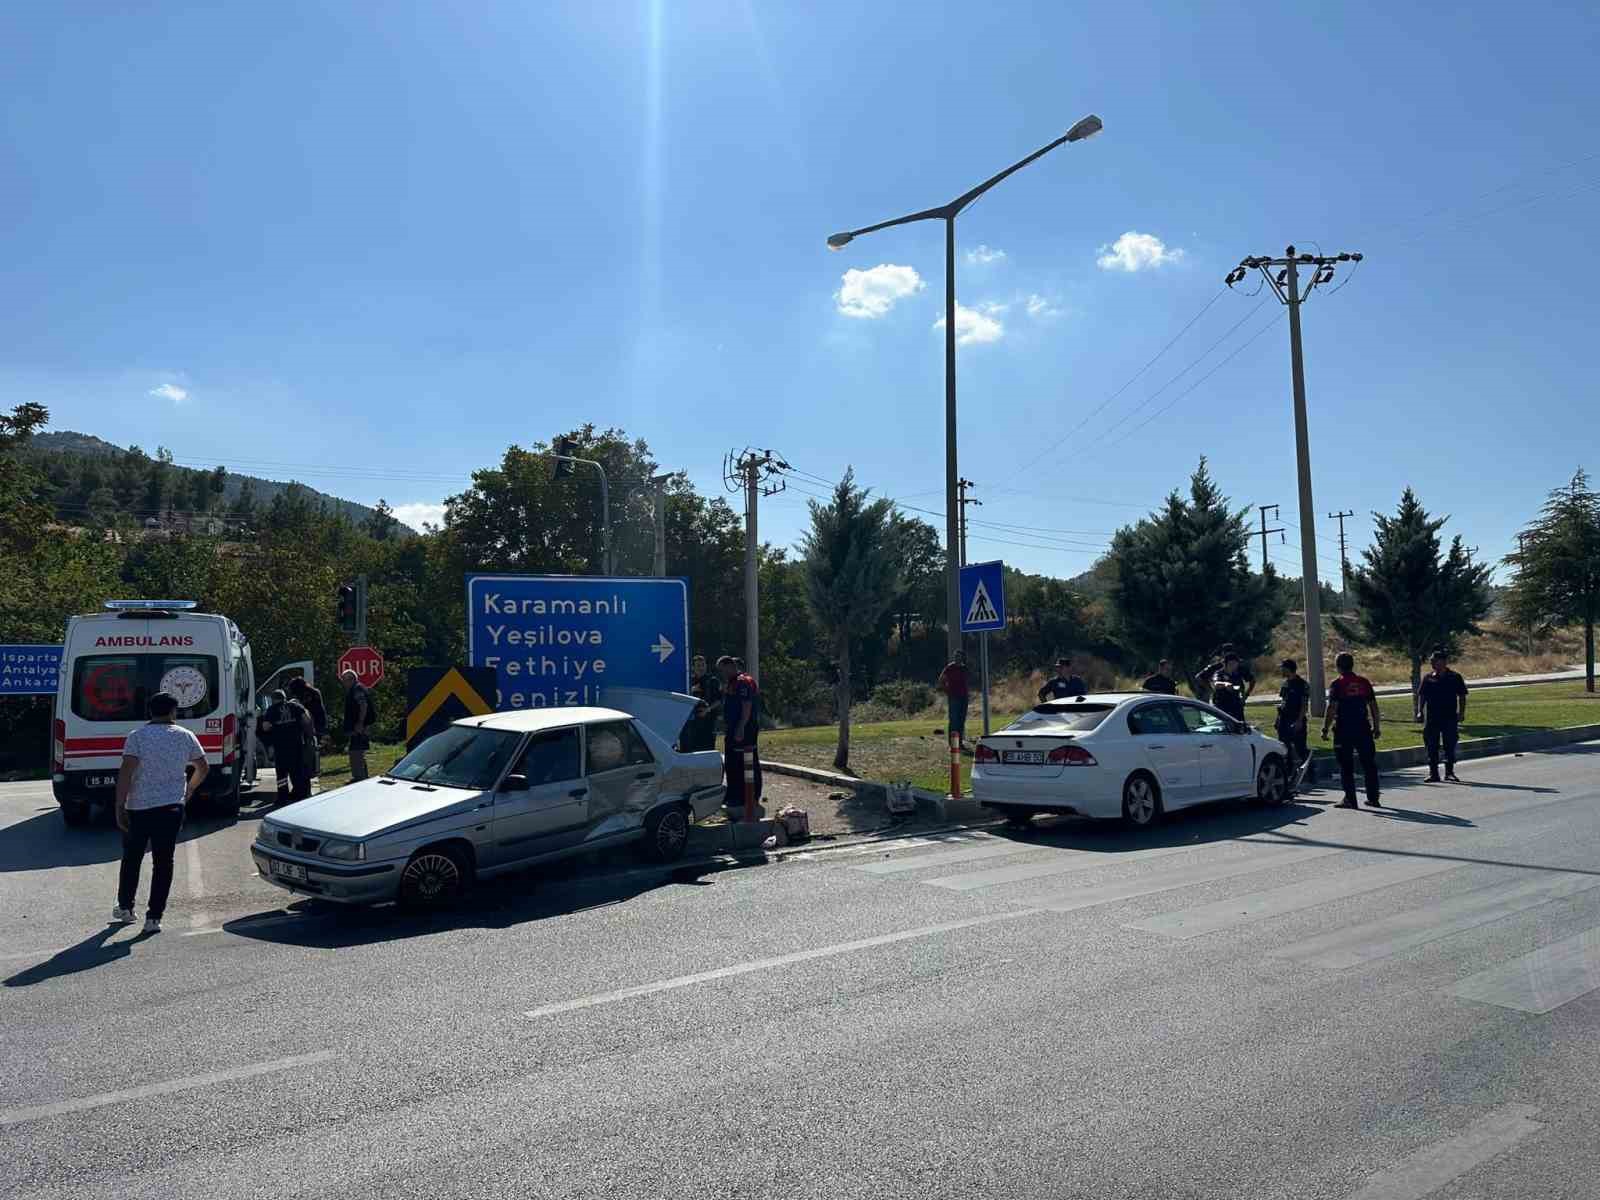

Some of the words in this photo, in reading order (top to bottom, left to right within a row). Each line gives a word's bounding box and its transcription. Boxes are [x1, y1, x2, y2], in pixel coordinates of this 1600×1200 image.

[484, 593, 627, 615] Karamanlı
[95, 636, 194, 647] AMBULANS
[486, 624, 603, 648] Yeşilova
[2, 652, 58, 663] Isparta
[2, 664, 57, 676] Antalya
[342, 659, 380, 676] DUR
[2, 677, 58, 688] Ankara
[207, 719, 221, 728] 112
